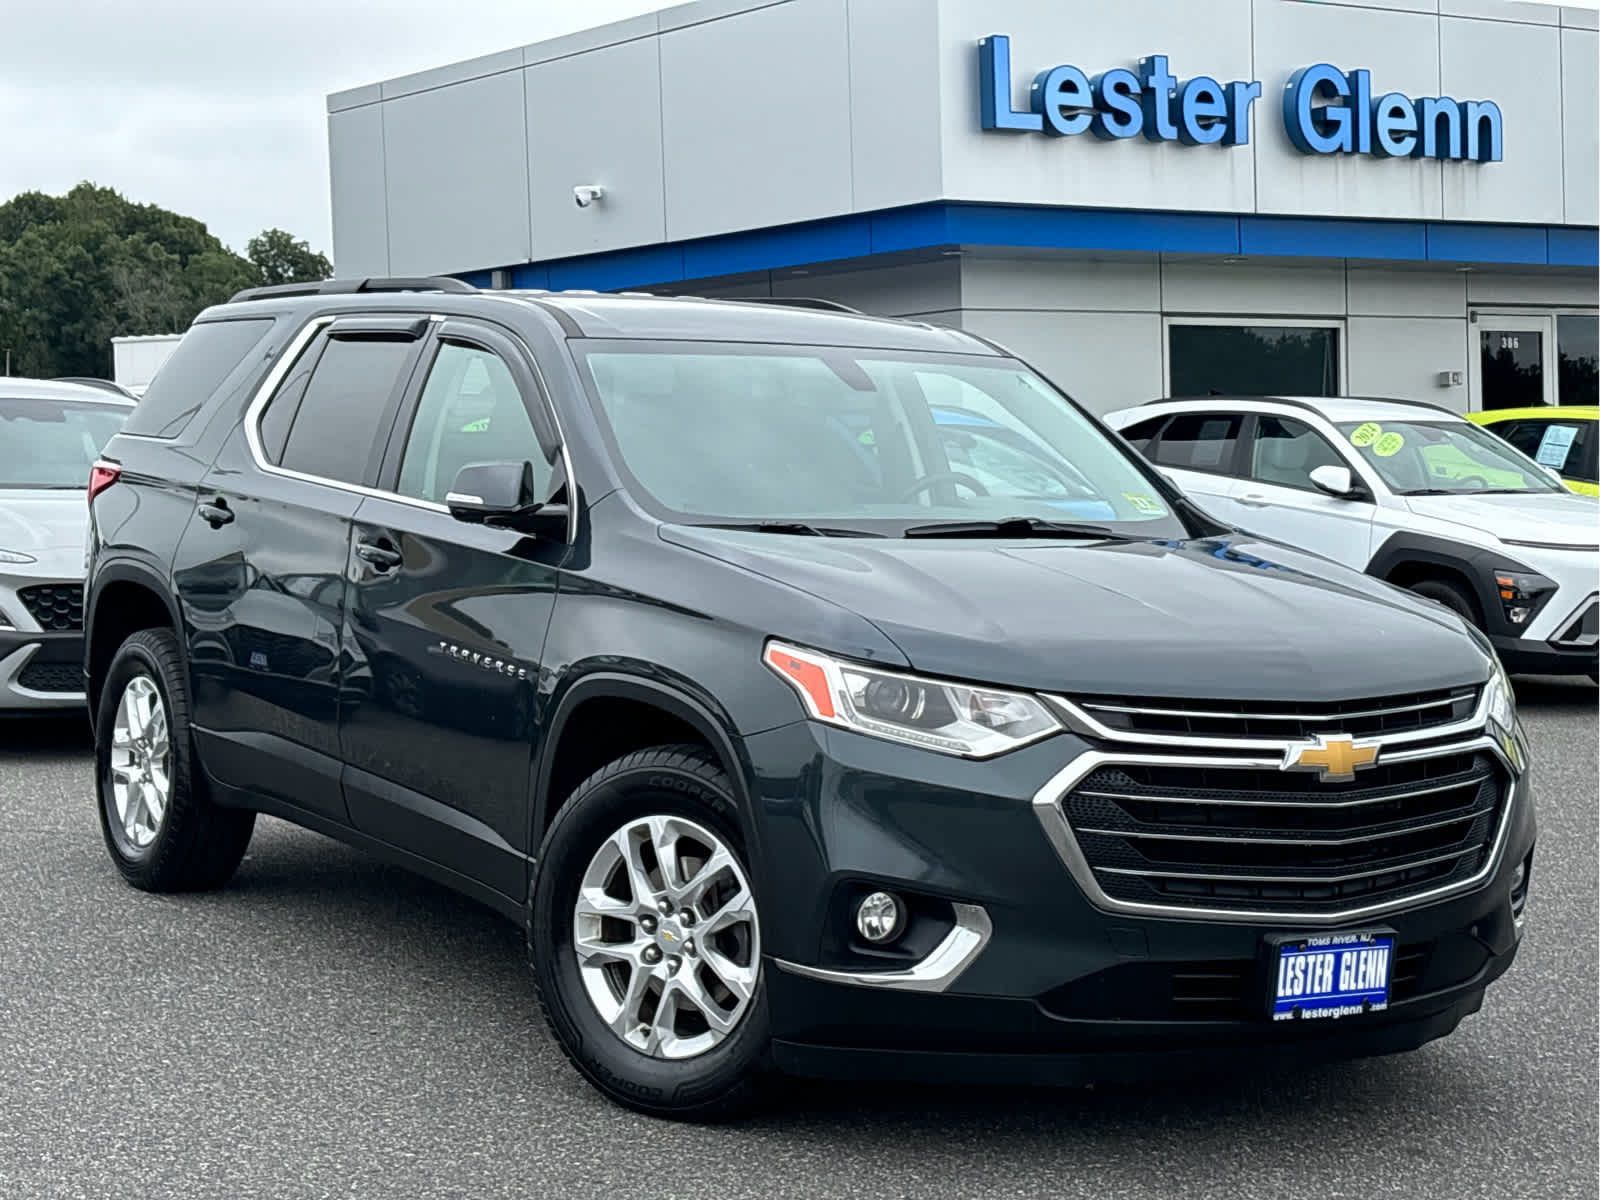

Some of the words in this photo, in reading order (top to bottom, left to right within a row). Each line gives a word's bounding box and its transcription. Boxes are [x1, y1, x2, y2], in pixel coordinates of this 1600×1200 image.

[979, 35, 1261, 146] Lester
[1283, 62, 1503, 162] Glenn
[439, 641, 527, 680] TRAVERSE
[1307, 936, 1331, 947] TOMS
[1359, 933, 1372, 942] NJ
[1277, 954, 1335, 997] LESTER
[1339, 949, 1389, 991] GLENN
[1301, 1004, 1363, 1019] lesterglenn
